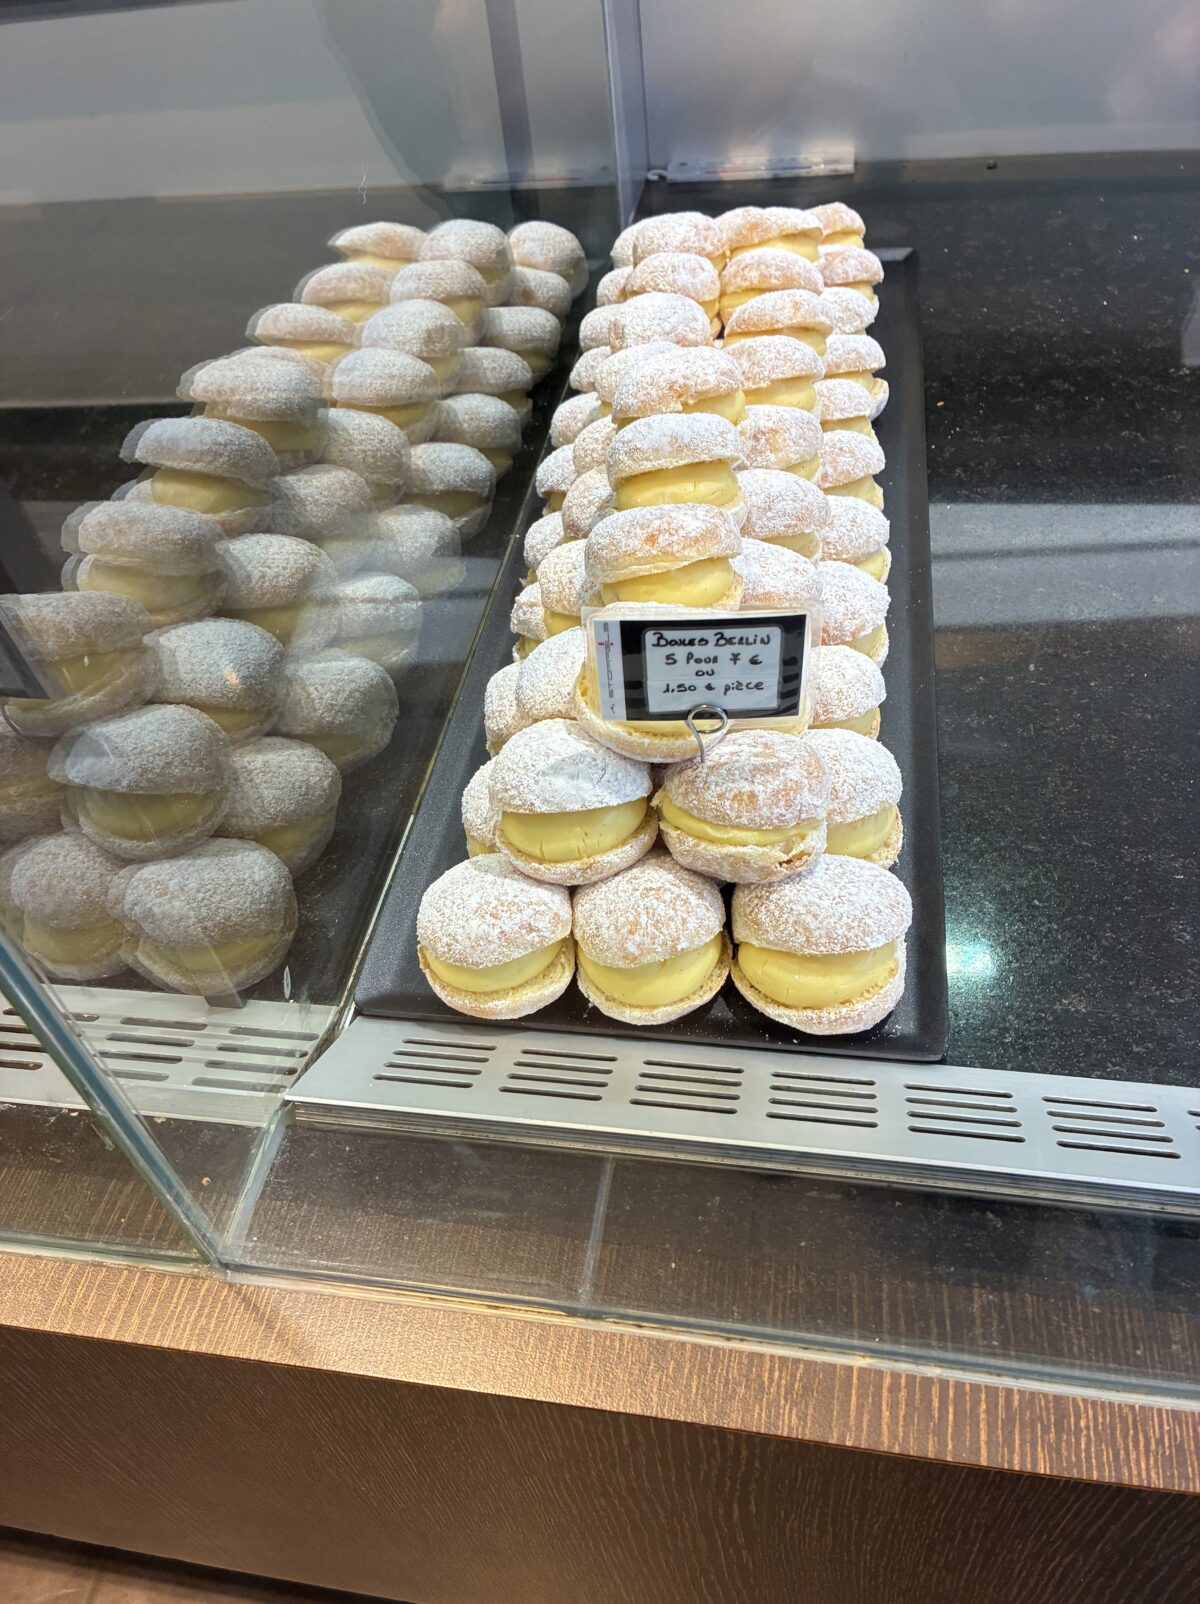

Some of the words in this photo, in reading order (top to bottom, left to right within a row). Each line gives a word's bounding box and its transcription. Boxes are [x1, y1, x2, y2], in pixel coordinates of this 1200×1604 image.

[664, 653, 678, 665] 5
[729, 652, 741, 665] 7
[749, 654, 763, 665] €
[704, 683, 716, 691] €
[723, 680, 765, 695] pièce
